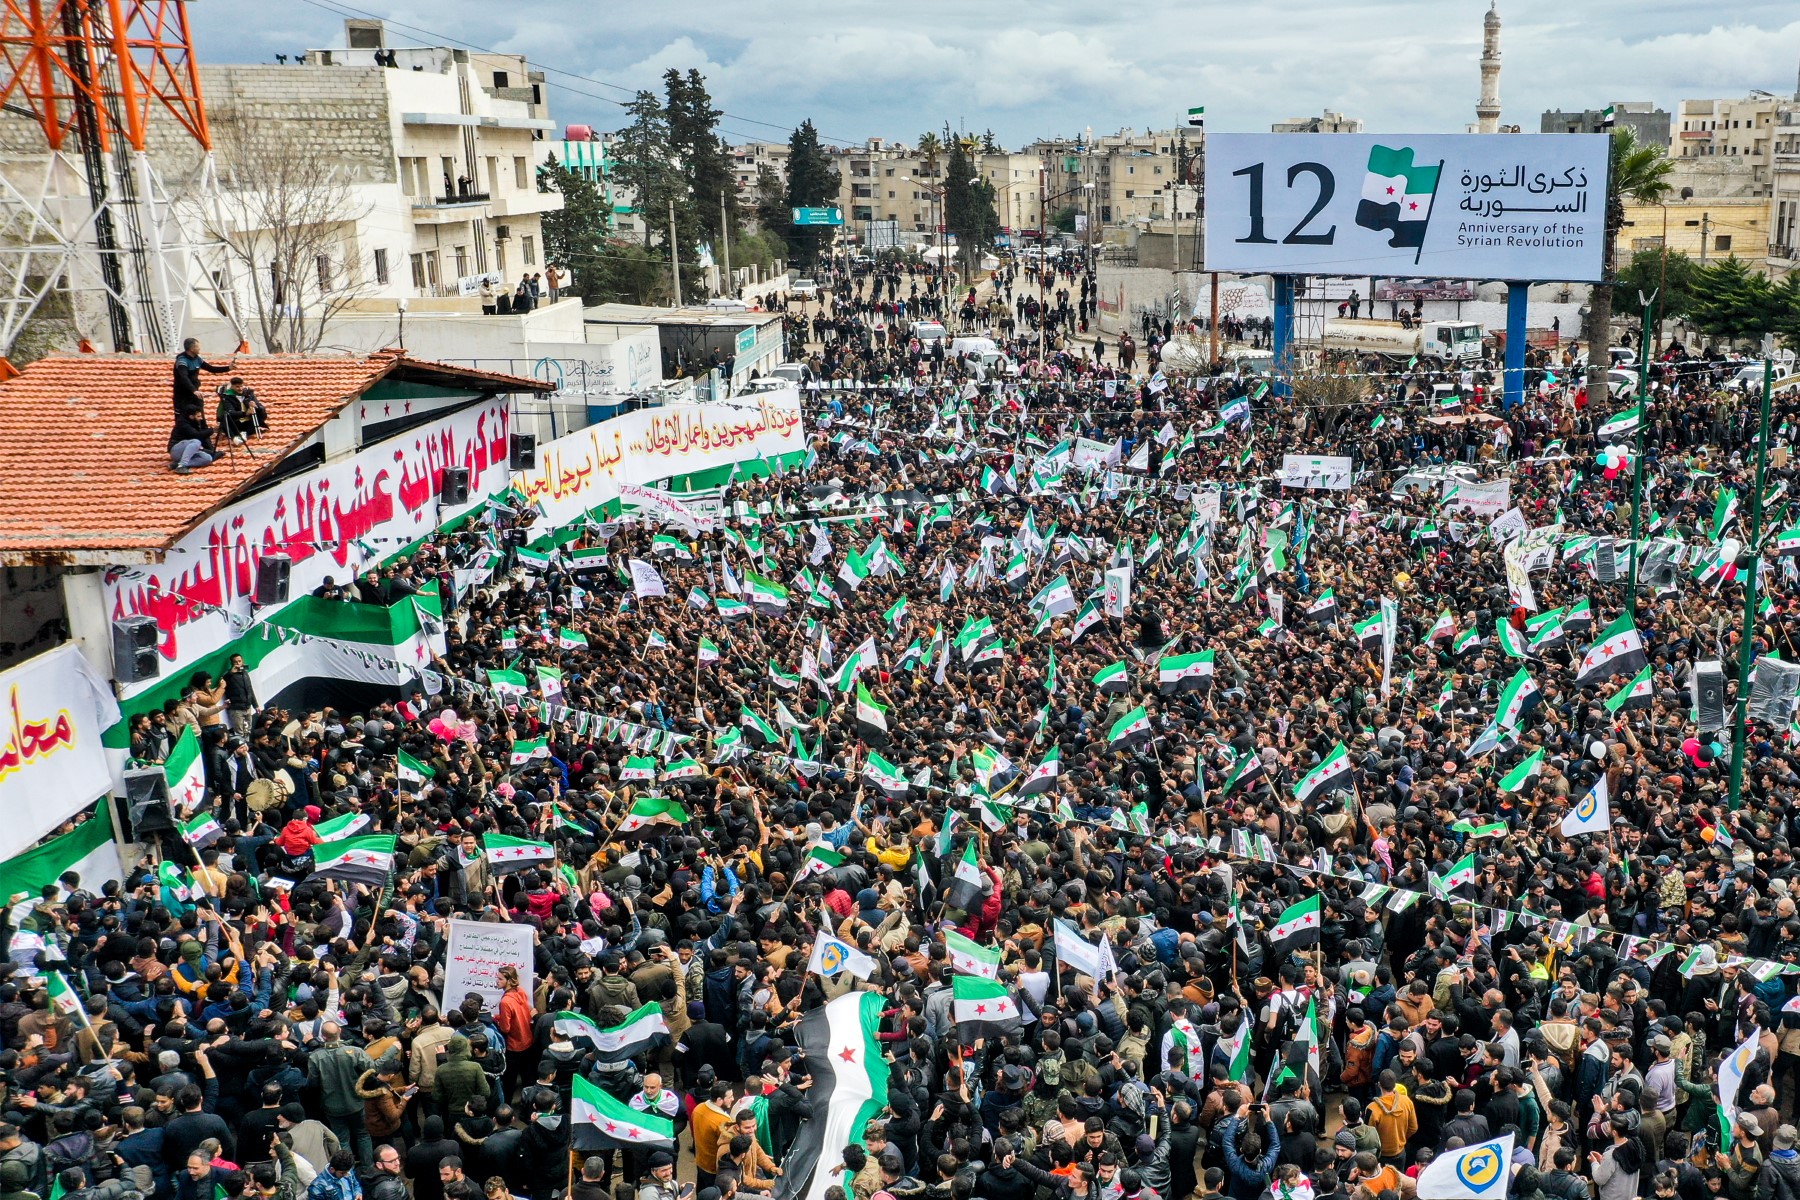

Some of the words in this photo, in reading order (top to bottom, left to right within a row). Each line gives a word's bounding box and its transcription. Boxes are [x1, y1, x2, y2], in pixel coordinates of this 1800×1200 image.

[1460, 165, 1526, 193] الثورة
[1527, 166, 1588, 194] ذكرى
[1232, 161, 1336, 245] 12
[1459, 191, 1587, 218] السورية
[1458, 222, 1539, 235] Anniversary
[1543, 223, 1557, 234] of
[1562, 224, 1584, 235] the
[1458, 235, 1501, 247] Syrian
[1507, 236, 1584, 248] Revolution
[318, 465, 394, 568] عشرة
